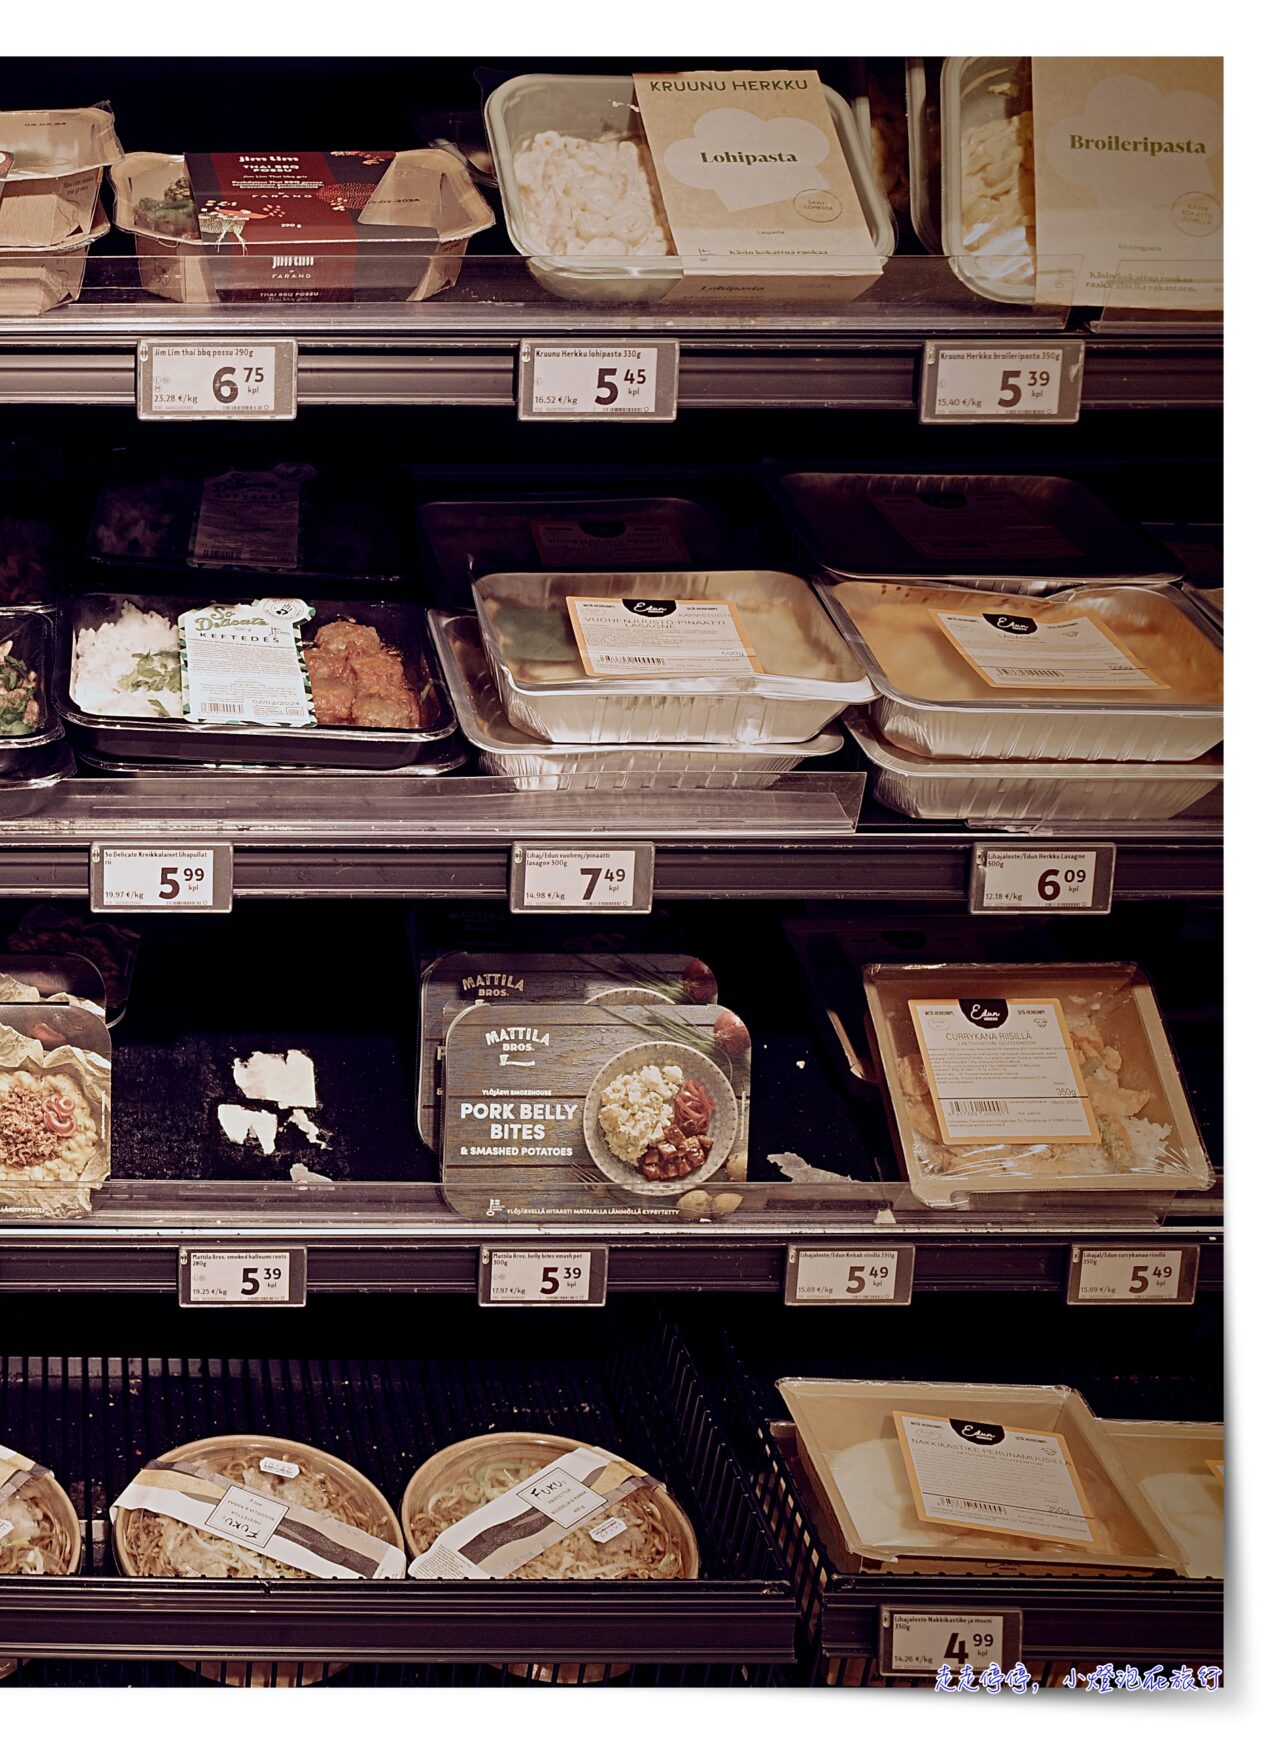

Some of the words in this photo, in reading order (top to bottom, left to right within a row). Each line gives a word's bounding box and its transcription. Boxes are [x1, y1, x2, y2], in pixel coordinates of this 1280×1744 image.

[650, 80, 727, 92] KRUUNU
[732, 80, 808, 91] HERKKU
[1070, 134, 1207, 157] Broileripasta
[700, 152, 798, 166] Lohipasta
[182, 348, 196, 356] thai
[198, 348, 211, 358] bbq
[213, 350, 233, 358] possu
[212, 367, 238, 404] 6
[244, 367, 264, 382] 75
[594, 368, 618, 405] 5
[624, 369, 646, 384] 45
[998, 370, 1022, 407] 5
[1028, 371, 1050, 386] 39
[210, 606, 235, 620] So
[194, 617, 269, 631] Delicate
[200, 632, 279, 643] KEFTEDES
[159, 867, 180, 899] 5
[184, 868, 204, 881] 99
[580, 868, 602, 900] 7
[604, 869, 625, 882] 49
[1038, 869, 1060, 901] 6
[1064, 870, 1086, 883] 09
[462, 973, 524, 991] MATTILA
[478, 988, 509, 997] BROS.
[971, 1004, 1000, 1020] Edun
[485, 1027, 550, 1046] MATTILA
[946, 1033, 998, 1041] CURRYKANA
[999, 1031, 1032, 1040] RIISILLÄ
[503, 1043, 535, 1051] BROS.
[1055, 1088, 1076, 1097] 350g
[461, 1103, 515, 1119] PORK
[520, 1103, 578, 1120] BELLY
[490, 1124, 545, 1140] BITES
[461, 1147, 468, 1155] &
[470, 1147, 519, 1155] SMASHED
[521, 1147, 573, 1156] POTATOES
[241, 1268, 260, 1295] 5
[264, 1268, 281, 1280] 39
[540, 1267, 559, 1296] 5
[564, 1267, 581, 1279] 39
[846, 1266, 865, 1294] 5
[869, 1266, 888, 1278] 49
[1129, 1266, 1148, 1293] 5
[1153, 1266, 1172, 1278] 49
[944, 1632, 969, 1664] 4
[973, 1634, 993, 1647] 99
